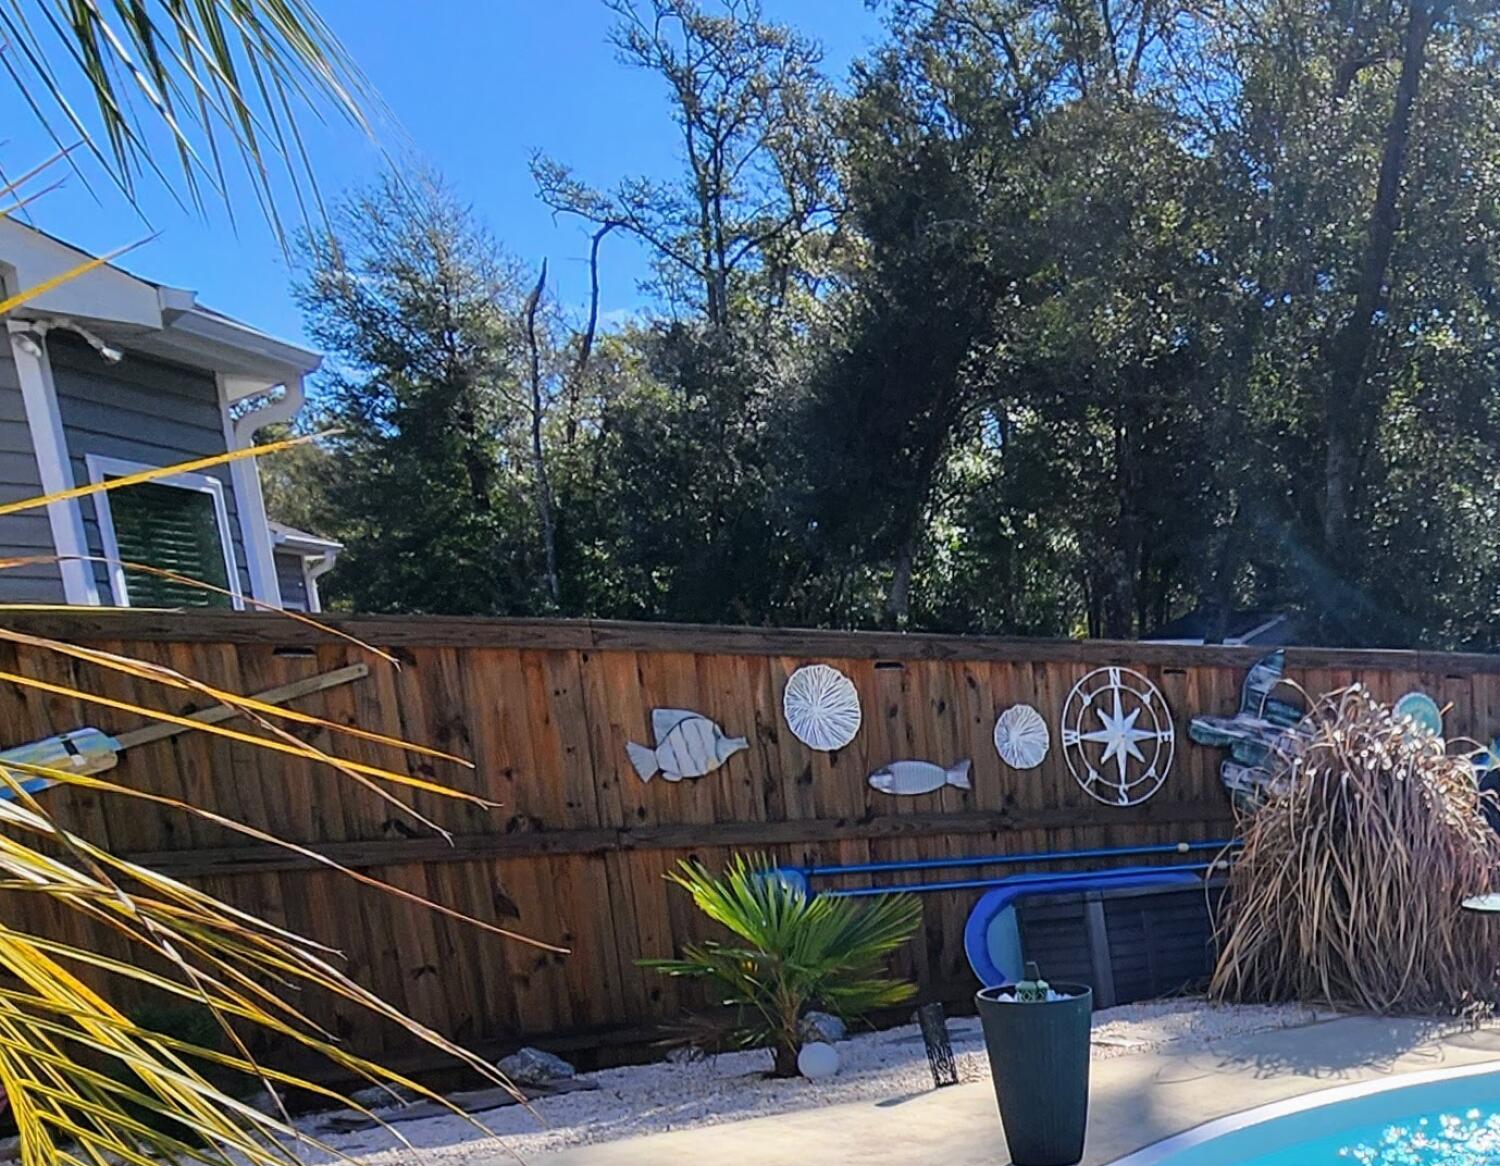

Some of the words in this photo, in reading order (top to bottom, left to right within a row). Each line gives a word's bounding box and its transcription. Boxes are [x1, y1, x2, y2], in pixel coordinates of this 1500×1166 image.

[1109, 667, 1121, 687] N
[1063, 730, 1079, 746] W
[1158, 731, 1174, 743] E
[1118, 785, 1129, 806] S
